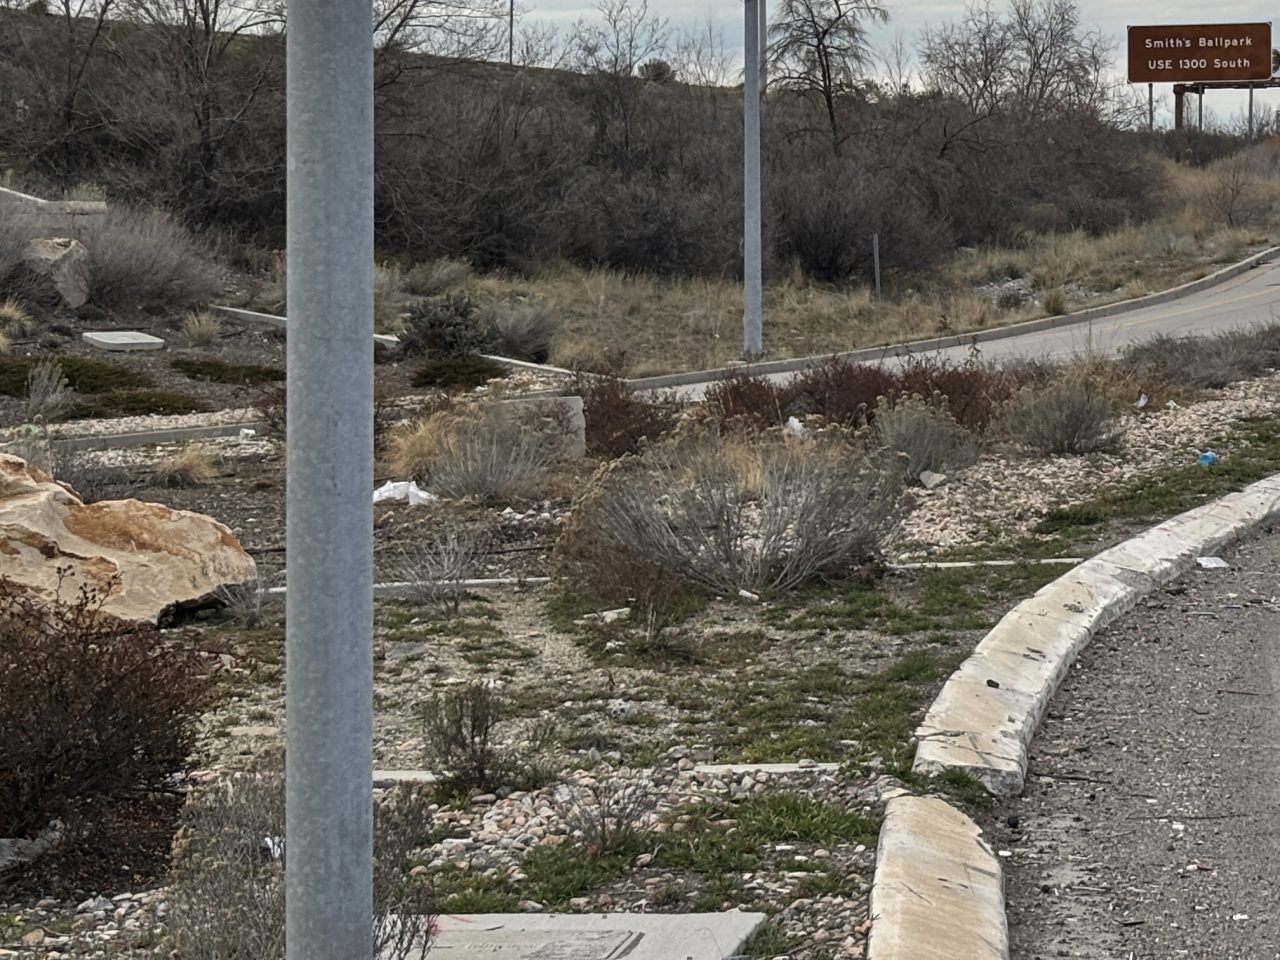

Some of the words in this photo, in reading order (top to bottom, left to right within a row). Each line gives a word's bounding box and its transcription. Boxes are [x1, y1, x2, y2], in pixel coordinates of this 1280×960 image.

[1145, 38, 1191, 49] Smith's
[1198, 36, 1253, 49] Ballpark
[1148, 59, 1173, 70] USE
[1179, 58, 1207, 69] 1300
[1213, 58, 1250, 68] South
